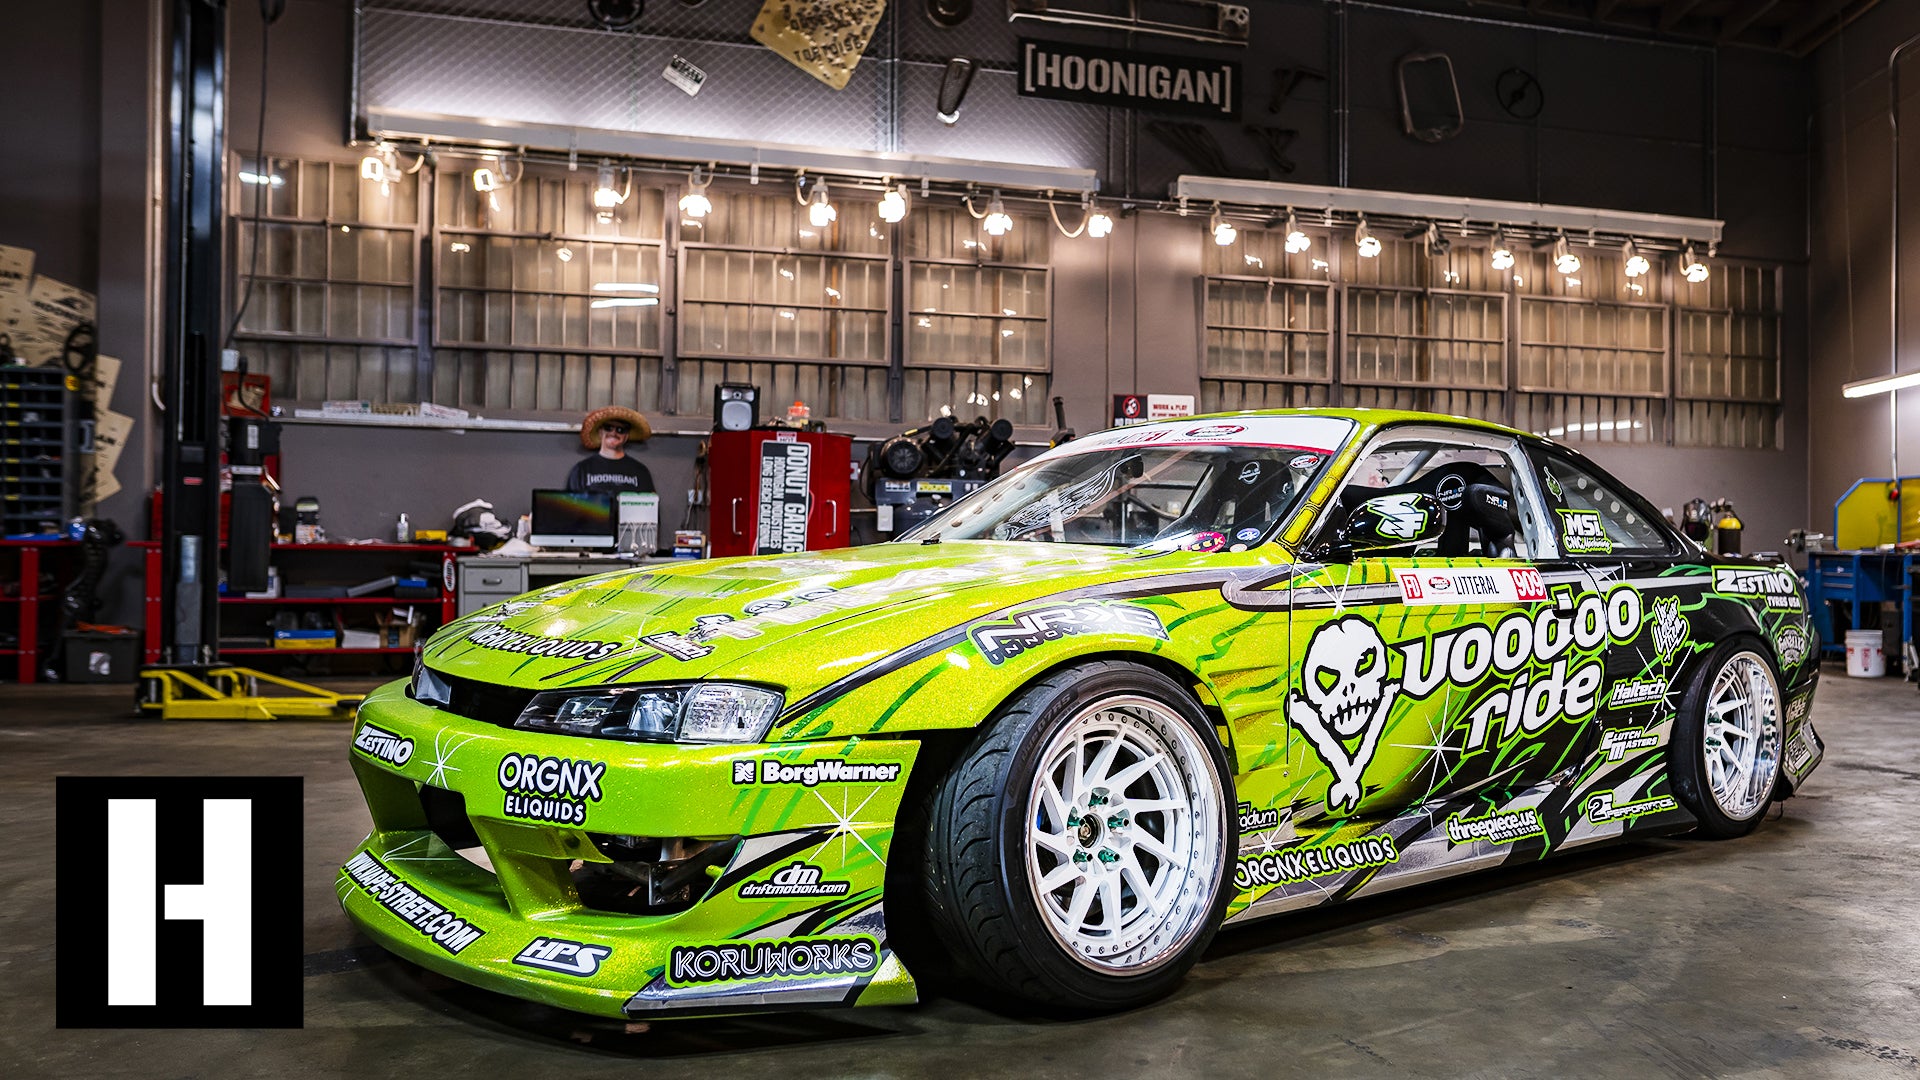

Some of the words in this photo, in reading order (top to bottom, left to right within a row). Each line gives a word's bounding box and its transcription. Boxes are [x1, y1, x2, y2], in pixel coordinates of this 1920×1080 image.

[1025, 44, 1232, 113] [HOONIGAN]
[762, 456, 774, 477] LONG
[772, 456, 786, 499] HOONIGAN
[785, 445, 809, 497] DONUT
[761, 478, 773, 503] BEACH
[758, 503, 772, 548] CALIFORNIA
[770, 500, 784, 549] INDUSTRIES
[782, 503, 806, 553] GARAG
[1452, 575, 1500, 595] LITTERAL
[1512, 570, 1545, 597] 909
[1716, 569, 1794, 594] ZESTINO
[1766, 596, 1788, 608] TYRES
[1612, 679, 1667, 701] Haltech
[1466, 659, 1601, 750] ride
[355, 726, 414, 764] ZESTINO
[1600, 730, 1642, 750] CLUTCH
[1608, 736, 1658, 761] MASTERS
[499, 755, 603, 799] ORGNX
[763, 762, 899, 784] BorgWarner
[505, 795, 584, 822] ELIQUIDS
[1238, 810, 1277, 828] adium
[1448, 809, 1537, 841] threepiece.us
[741, 882, 848, 896] driftmotion.com
[517, 938, 608, 974] HPS
[675, 942, 874, 979] KORUWORKS
